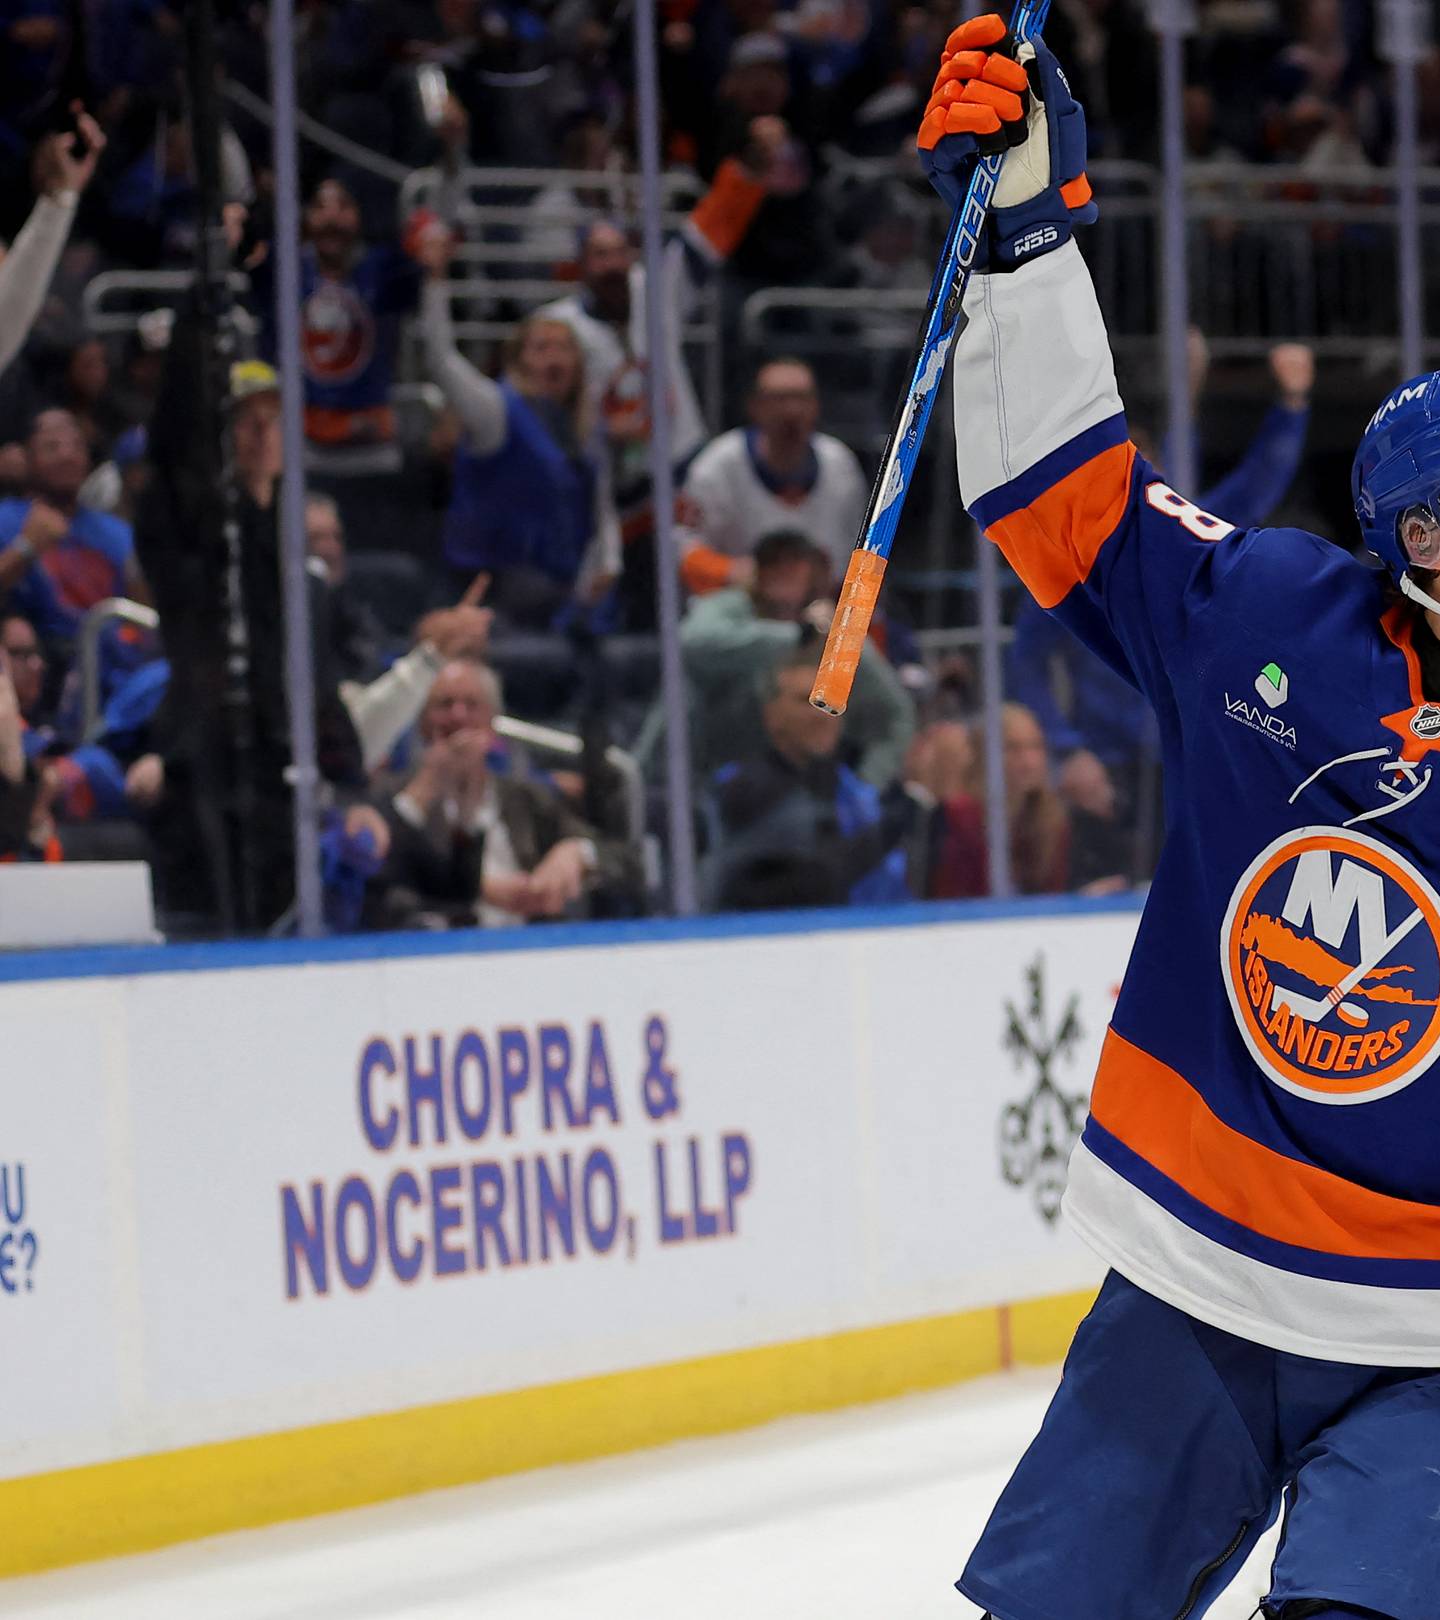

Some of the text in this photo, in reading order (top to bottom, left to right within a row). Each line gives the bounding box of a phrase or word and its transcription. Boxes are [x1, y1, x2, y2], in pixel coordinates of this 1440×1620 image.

[955, 153, 1004, 268] PEED
[1014, 230, 1058, 257] CCM
[1144, 481, 1237, 543] 8
[1224, 691, 1297, 745] VANDA
[1281, 848, 1388, 966] NY
[1244, 950, 1411, 1072] ISLANDERS
[357, 1014, 679, 1153] CHOPRA &
[280, 1132, 753, 1301] NOCERINO, LLP
